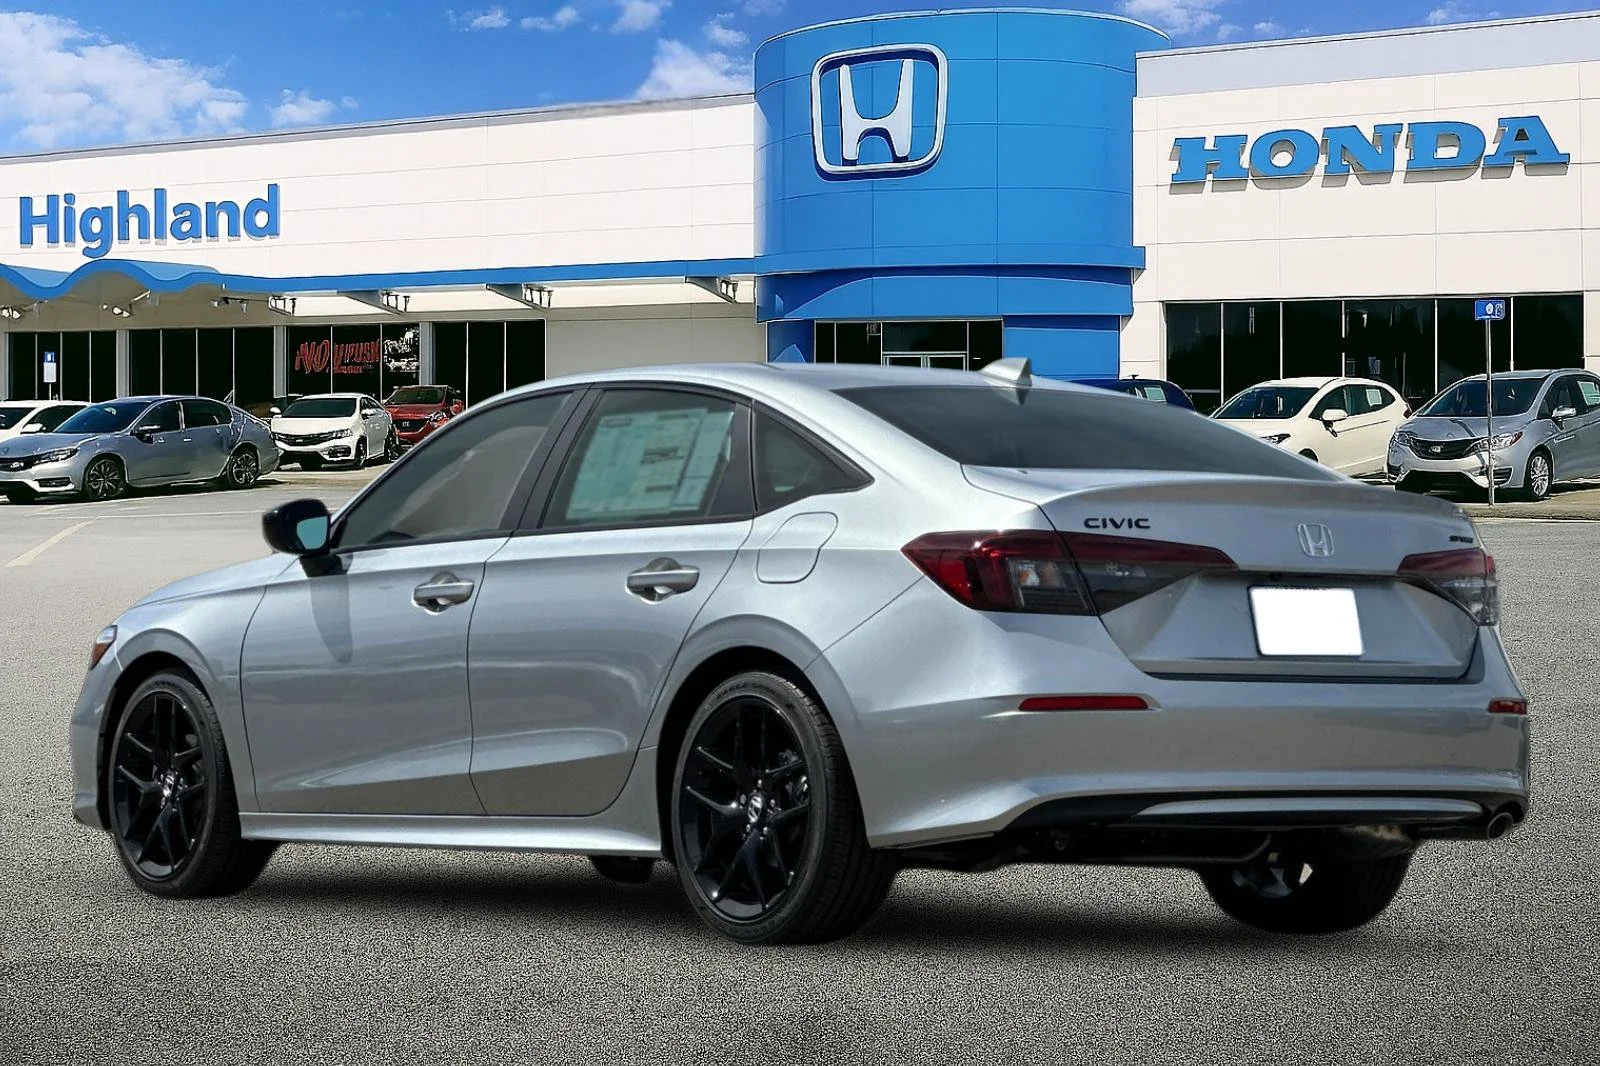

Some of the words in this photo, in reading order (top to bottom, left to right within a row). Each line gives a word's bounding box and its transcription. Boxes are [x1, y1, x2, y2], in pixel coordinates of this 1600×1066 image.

[1171, 115, 1571, 184] HONDA
[19, 183, 281, 259] Highland
[1083, 517, 1152, 529] CIVIC
